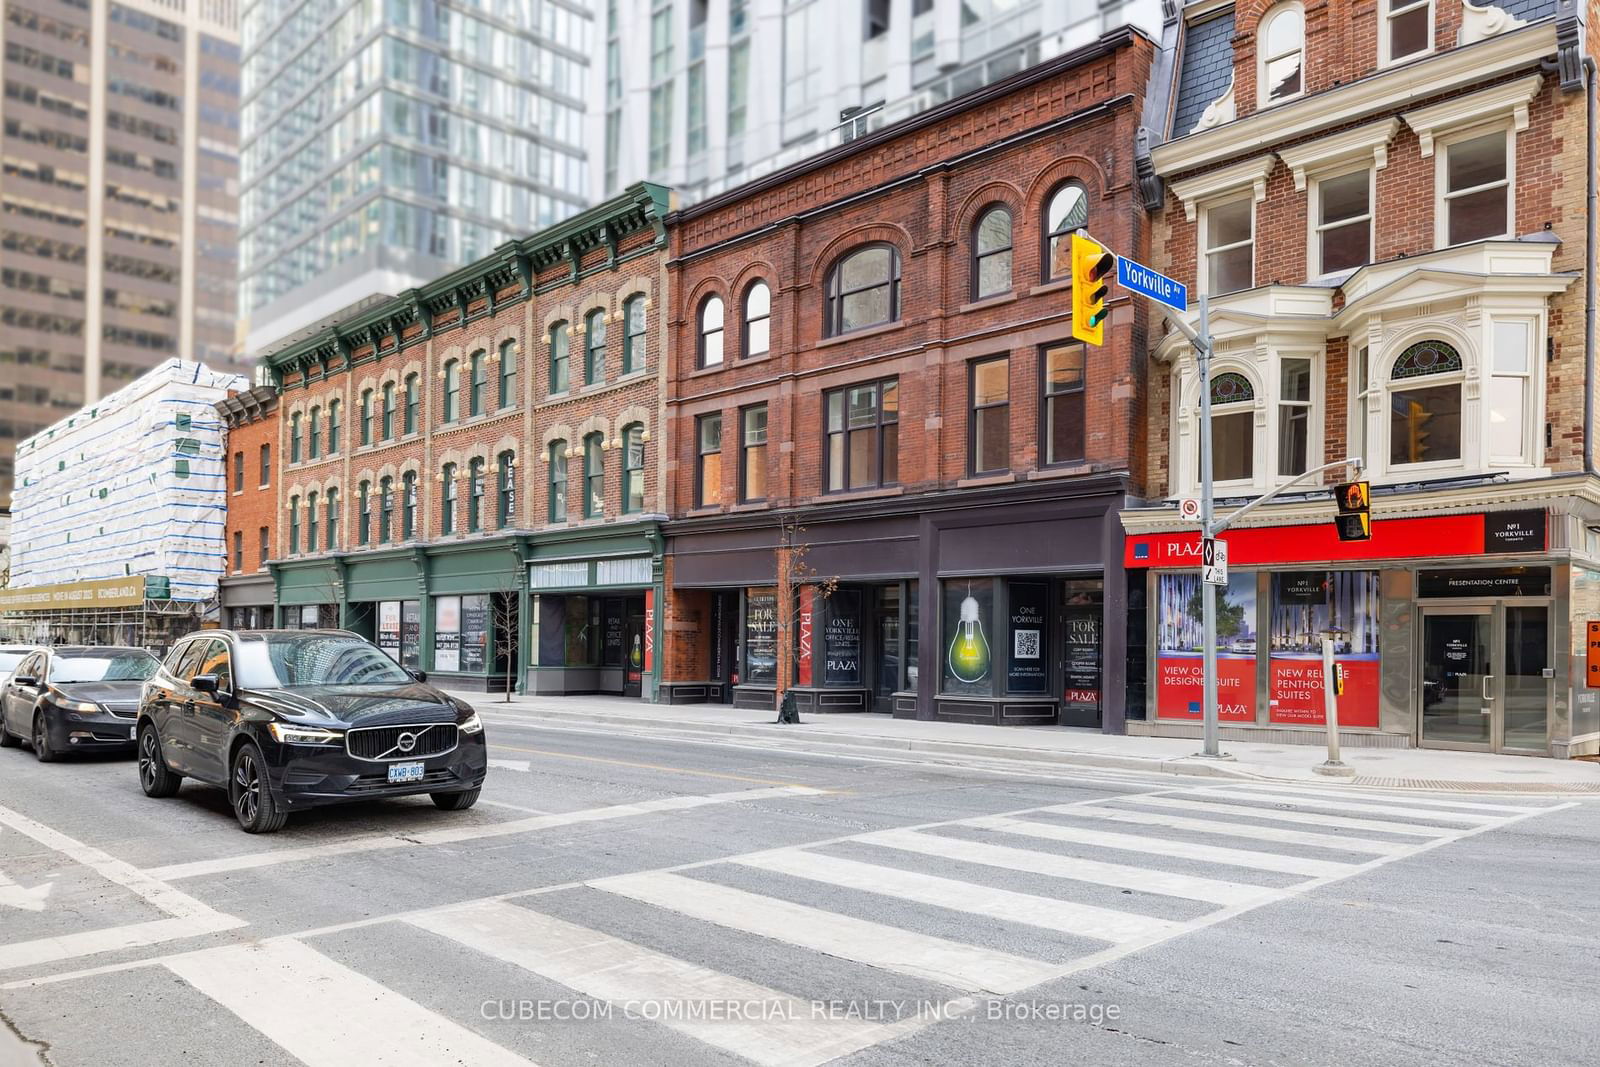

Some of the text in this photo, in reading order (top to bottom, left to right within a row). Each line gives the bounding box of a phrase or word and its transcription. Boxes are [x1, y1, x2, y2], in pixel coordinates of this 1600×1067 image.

[1125, 261, 1181, 298] Yorkville Av
[507, 456, 515, 513] LEASE
[1168, 542, 1203, 557] PLAZ
[754, 608, 773, 620] FOR
[1020, 606, 1036, 614] ONE
[832, 619, 854, 627] ONE
[1011, 615, 1043, 623] YORKVILLE
[645, 609, 654, 653] PLAZA
[751, 621, 776, 632] SALE
[1072, 621, 1095, 632] FOR
[801, 613, 811, 659] PLAZA
[1069, 633, 1099, 644] SALE
[827, 660, 856, 671] PLAZA
[1164, 666, 1189, 674] VIEW
[1277, 669, 1303, 677] NEW
[1164, 677, 1205, 686] DESIGNE
[1277, 680, 1326, 689] PENTHOU
[1071, 691, 1097, 701] PLAZA
[1277, 690, 1311, 700] SUITES
